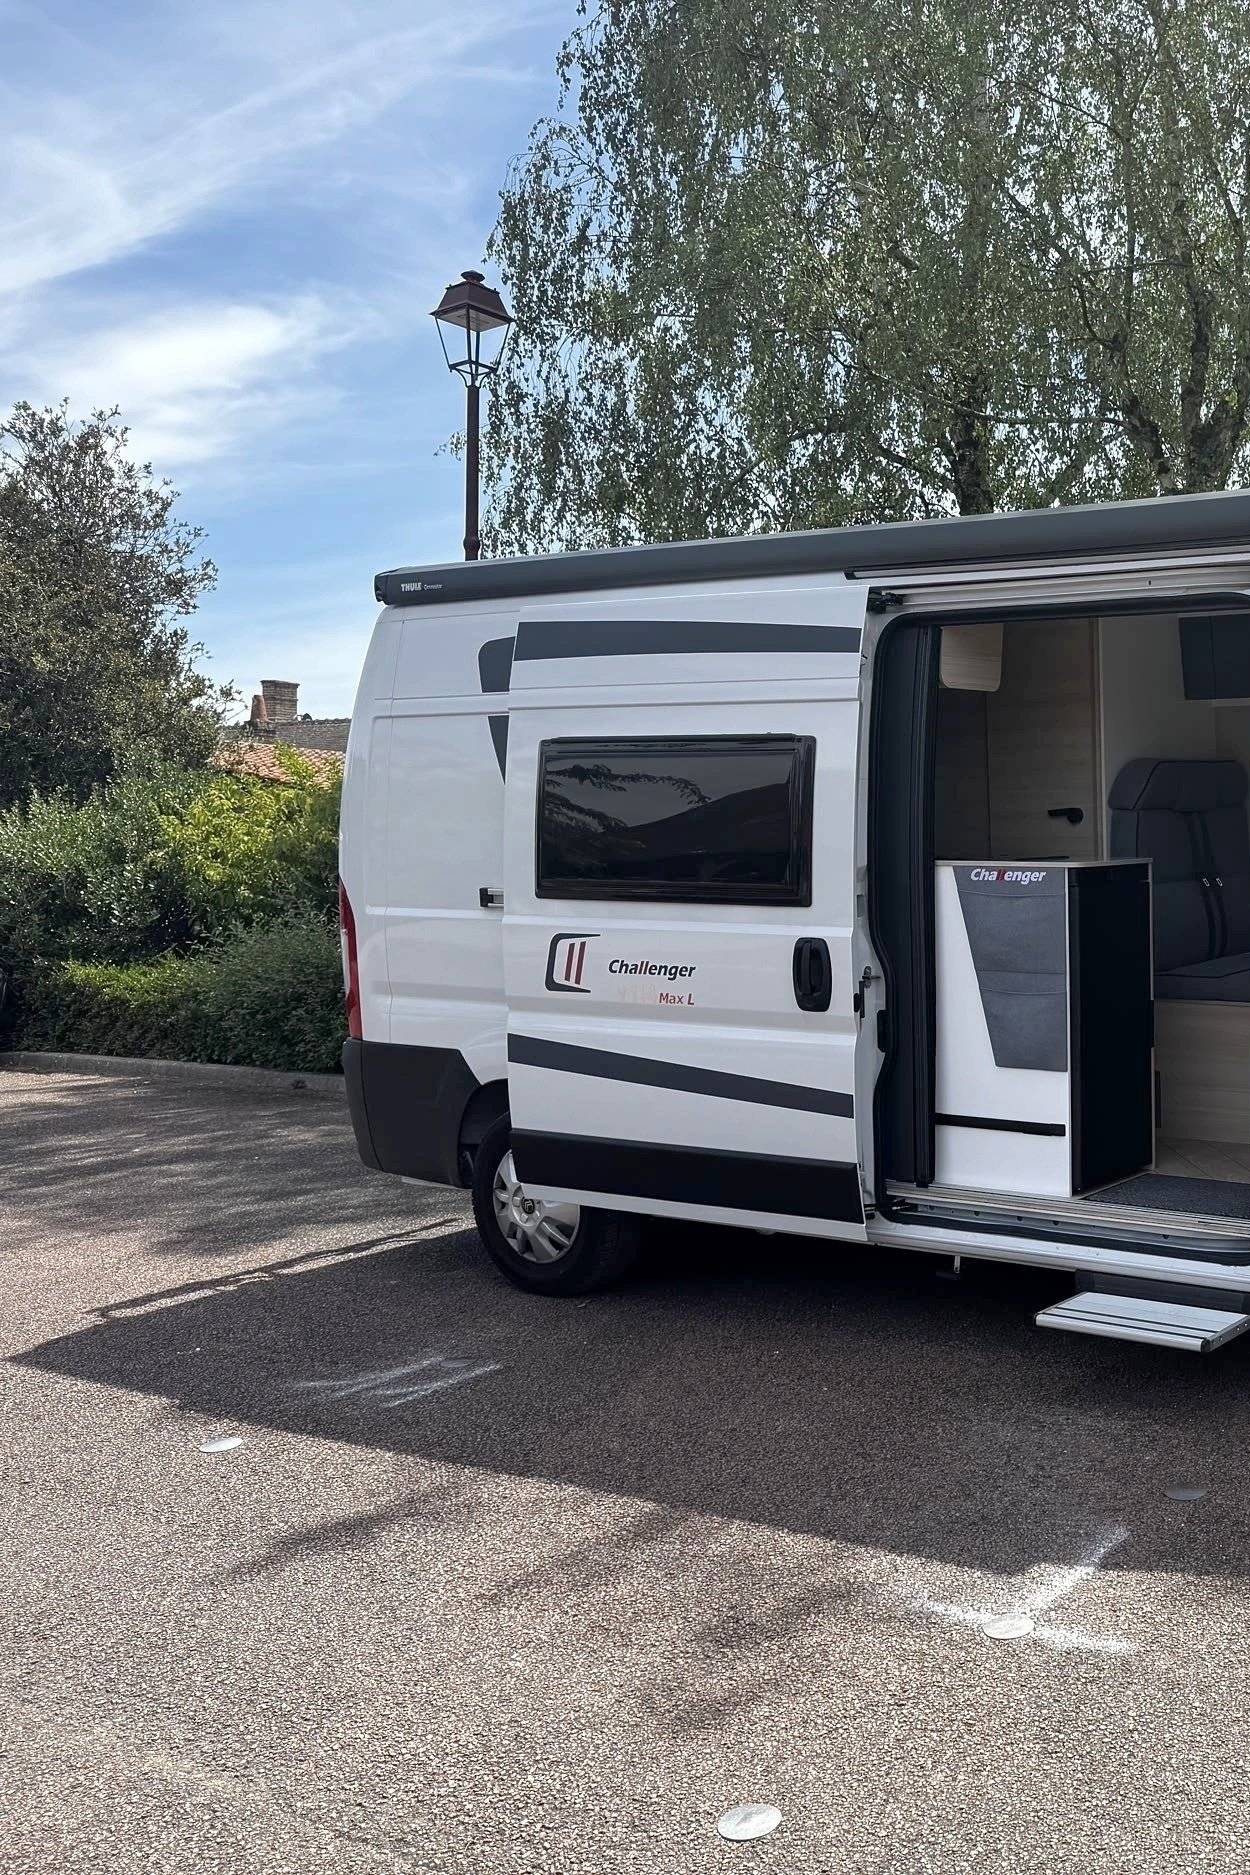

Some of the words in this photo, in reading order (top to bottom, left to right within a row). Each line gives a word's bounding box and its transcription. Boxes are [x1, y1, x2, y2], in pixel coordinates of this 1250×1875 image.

[400, 582, 422, 591] THULE
[970, 868, 1047, 885] Challenger
[608, 959, 697, 981] Challenger
[658, 992, 684, 1005] Max
[687, 993, 695, 1006] L
